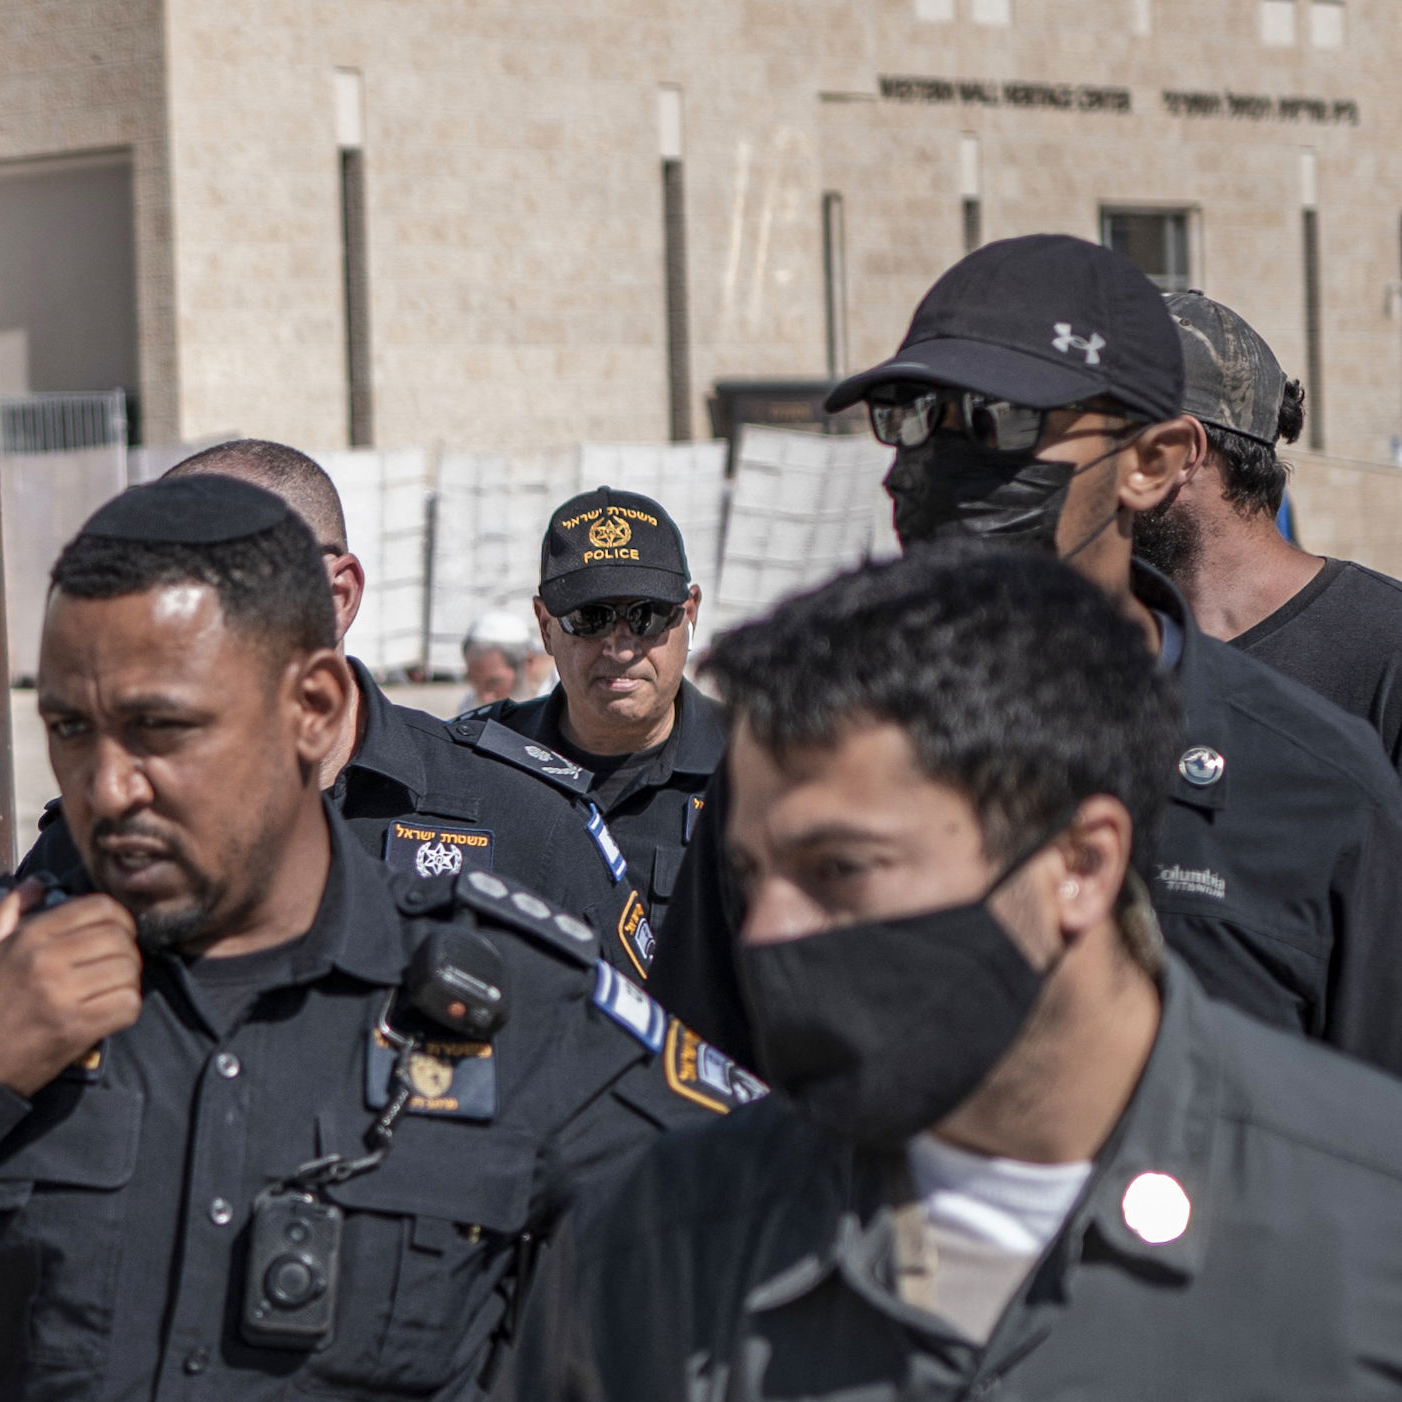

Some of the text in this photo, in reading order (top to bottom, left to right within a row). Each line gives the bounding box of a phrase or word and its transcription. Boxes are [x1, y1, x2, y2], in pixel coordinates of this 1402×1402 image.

[562, 506, 658, 530] משטרת ישראל
[583, 548, 640, 564] POLICE
[395, 823, 489, 847] משטרת ישראל
